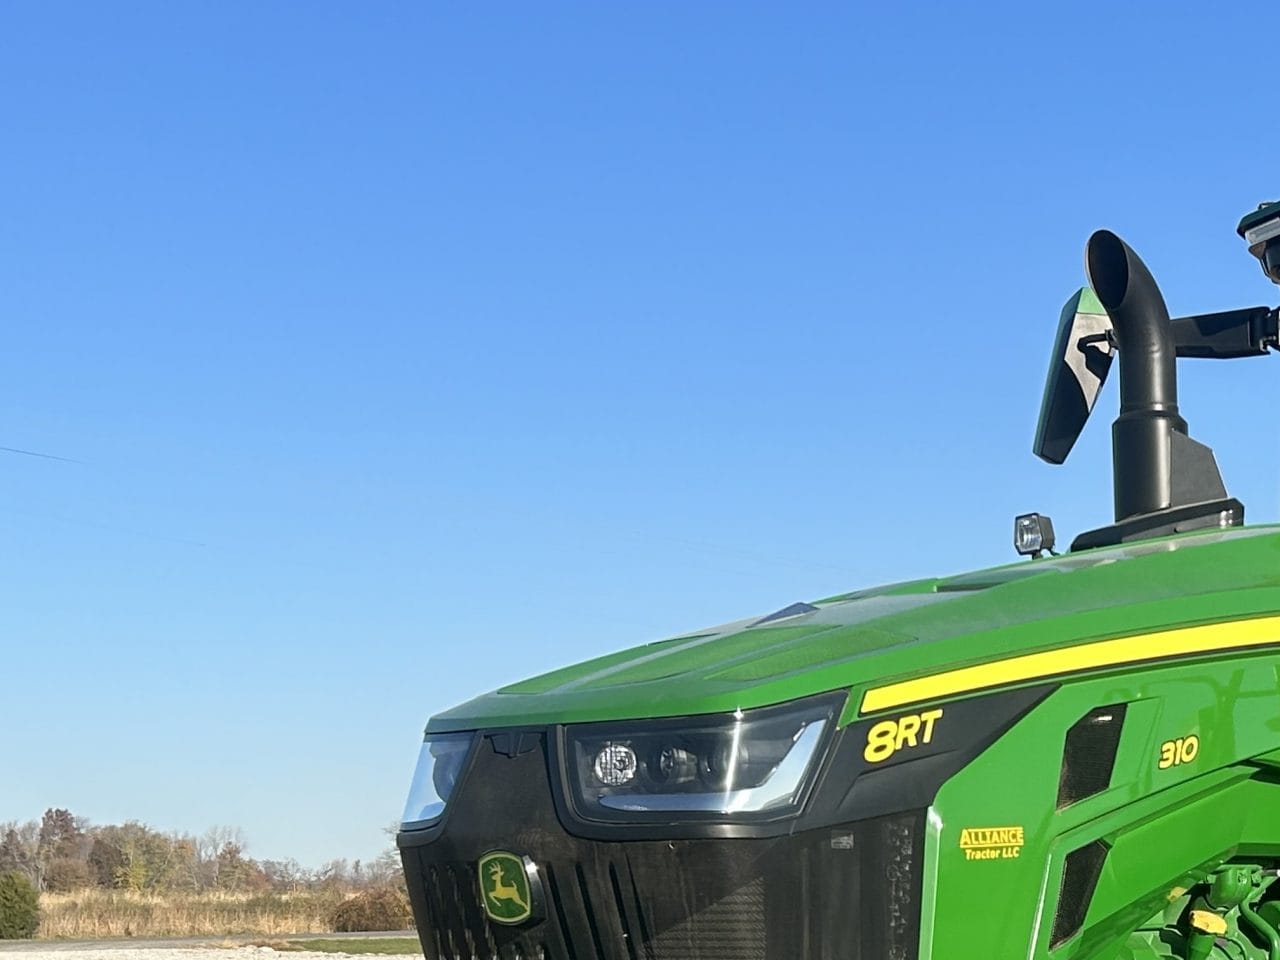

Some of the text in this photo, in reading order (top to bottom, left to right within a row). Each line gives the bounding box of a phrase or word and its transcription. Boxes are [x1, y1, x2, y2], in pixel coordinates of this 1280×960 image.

[864, 708, 944, 763] 8RT
[1158, 735, 1199, 770] 310
[960, 828, 1024, 848] ALLIANCE
[965, 846, 1020, 860] Tractor LLC
